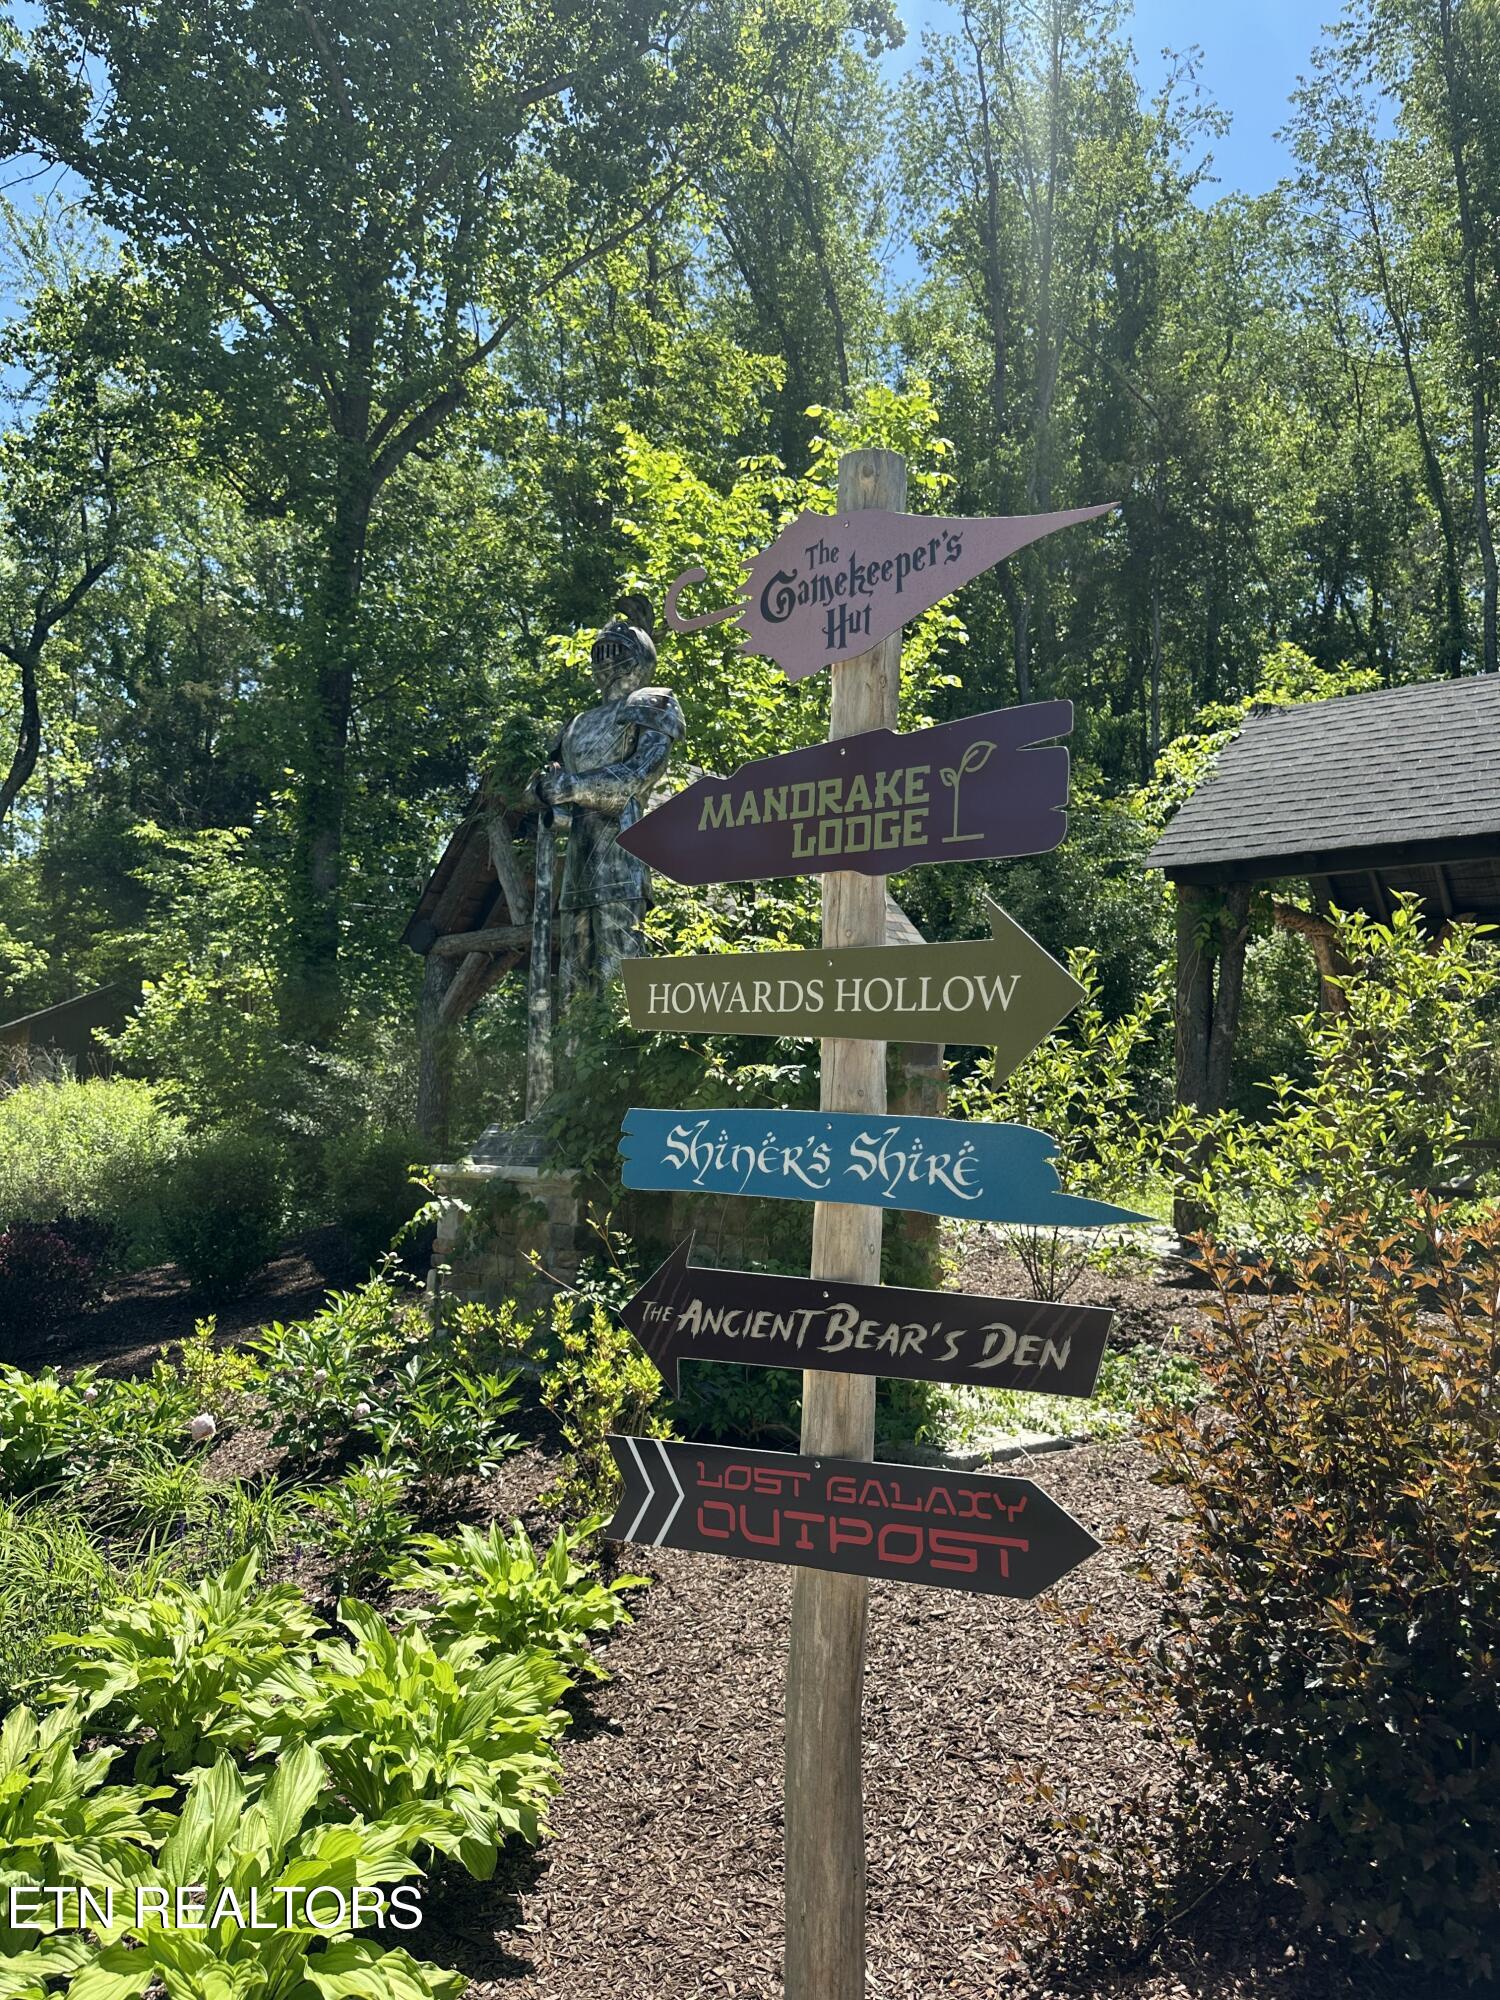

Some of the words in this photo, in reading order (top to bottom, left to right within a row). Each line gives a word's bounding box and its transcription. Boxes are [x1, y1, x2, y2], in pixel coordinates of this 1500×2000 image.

[760, 530, 964, 623] Gamekeeper's
[804, 538, 840, 571] The
[823, 603, 873, 650] Hut
[698, 765, 931, 831] MANDRAKE
[791, 807, 930, 858] LODGE
[647, 979, 824, 1014] HOWARDS
[834, 974, 1021, 1013] HOLLOW
[696, 1461, 811, 1498] LOST
[826, 1475, 1028, 1522] GALAXY
[697, 1501, 1030, 1579] OUTPOST
